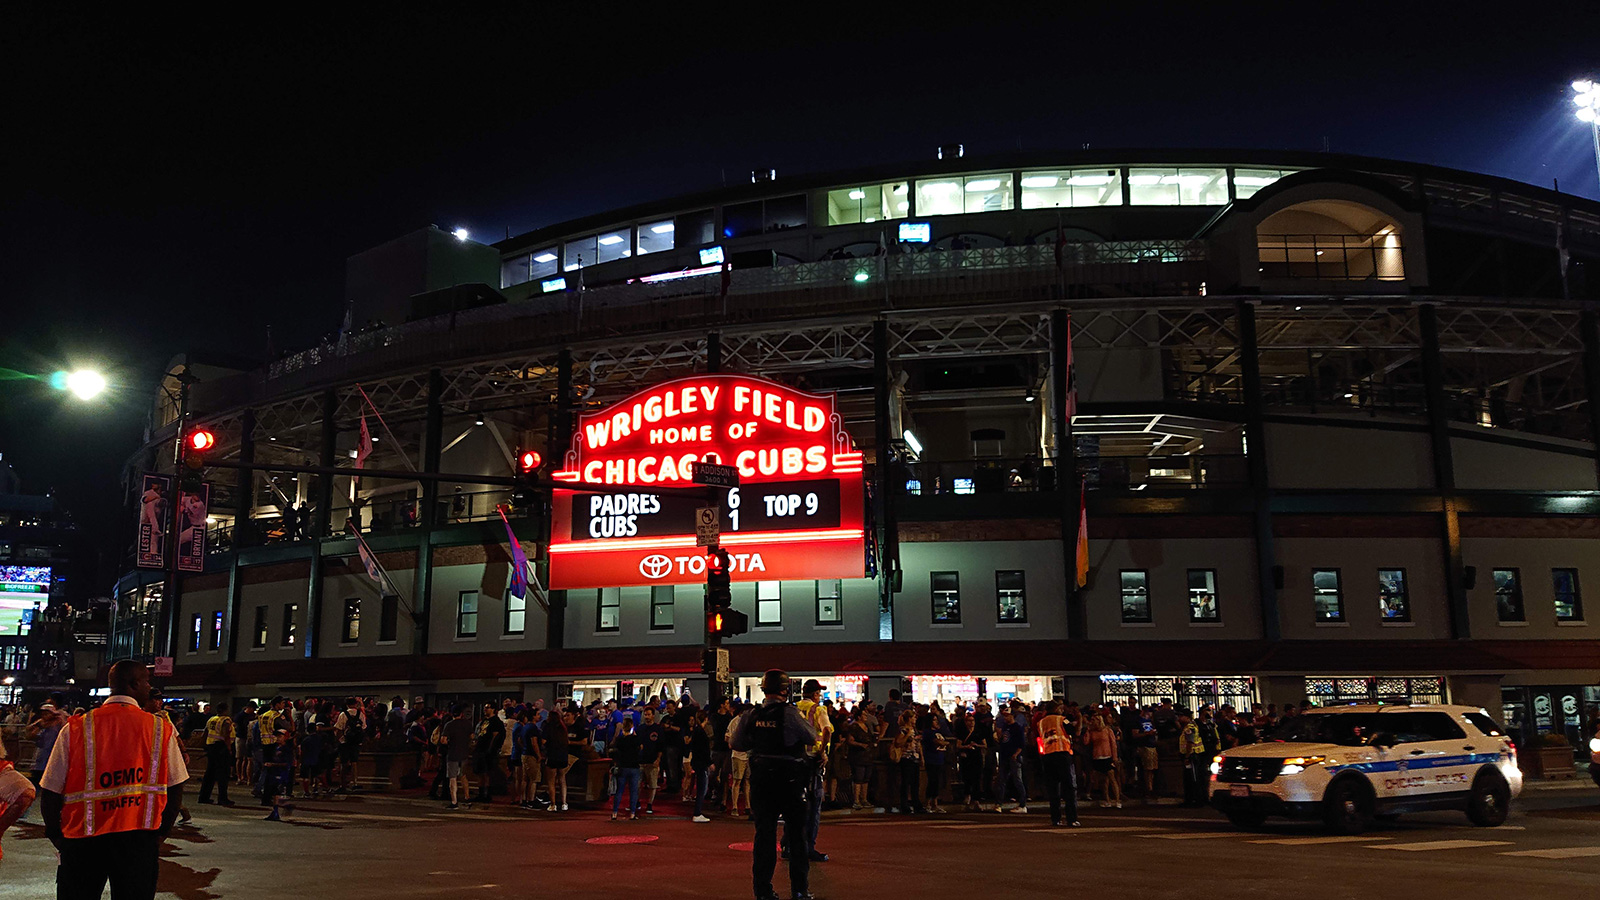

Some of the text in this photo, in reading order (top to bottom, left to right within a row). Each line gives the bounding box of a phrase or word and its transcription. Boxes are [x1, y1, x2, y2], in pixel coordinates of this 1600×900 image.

[585, 385, 826, 449] WRIGLEY FIELD
[649, 421, 758, 444] HOME OF
[700, 465, 730, 476] ADDISON
[736, 445, 827, 477] CUBS
[590, 487, 740, 516] PADRES 6
[763, 493, 818, 517] TOP 9
[589, 509, 739, 538] CUBS 1
[141, 526, 151, 551] LESTER
[193, 530, 202, 556] BRYANT
[675, 553, 766, 575] TOOTA
[756, 720, 776, 728] POLICE
[100, 767, 143, 788] OEMC
[1386, 773, 1468, 790] CHICAGO POLICE
[101, 796, 141, 811] TRAFFC
